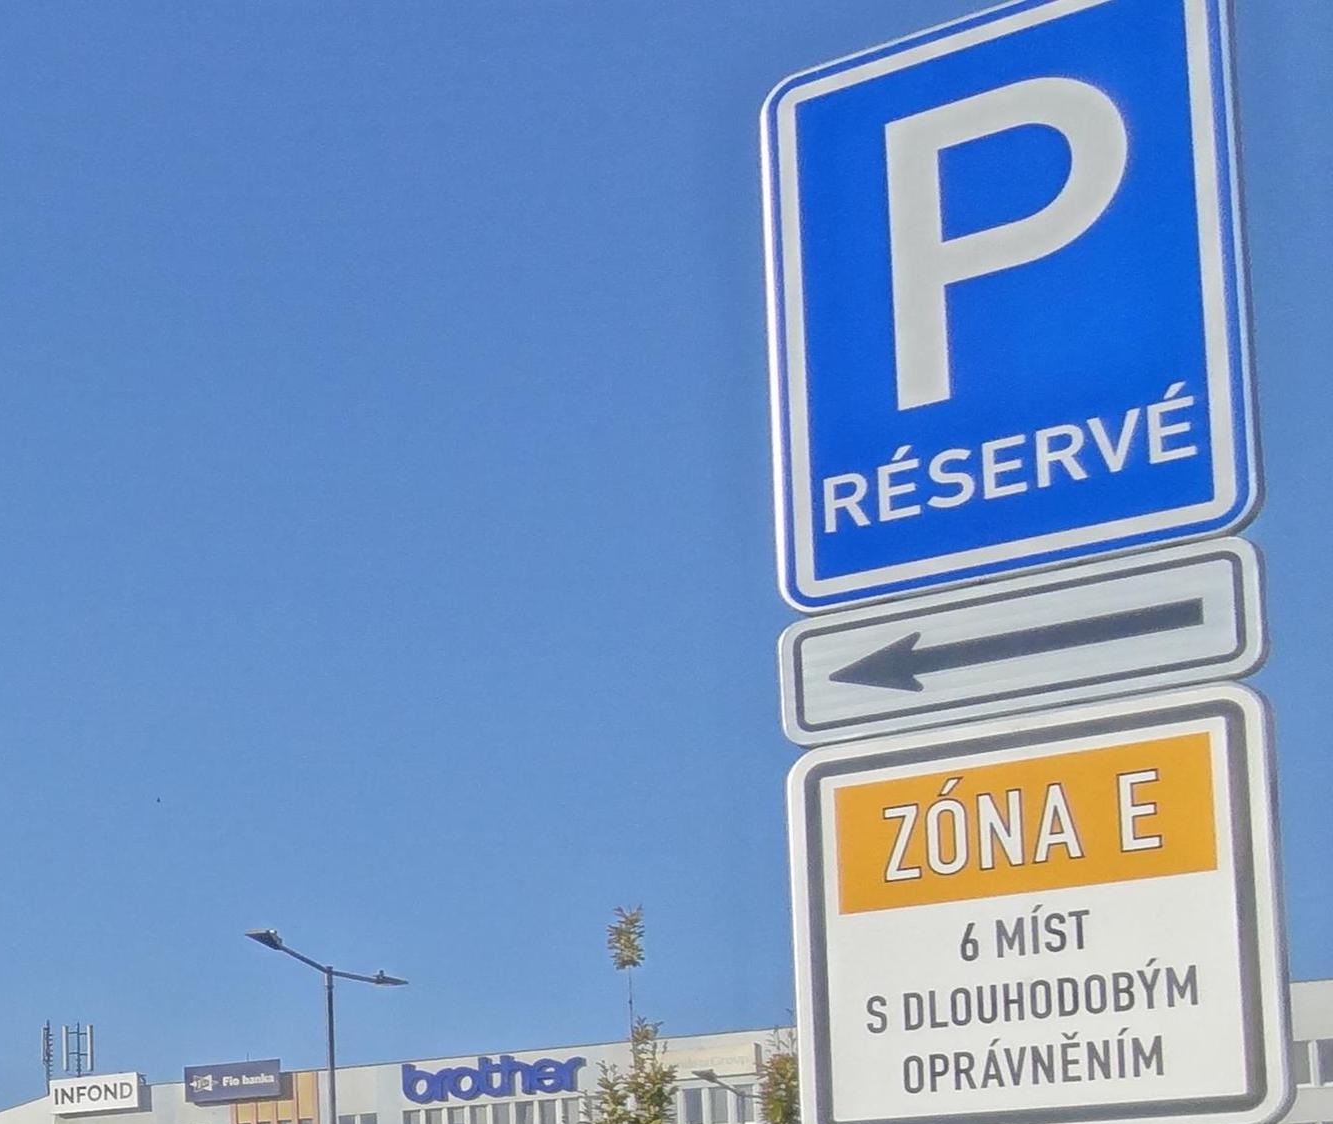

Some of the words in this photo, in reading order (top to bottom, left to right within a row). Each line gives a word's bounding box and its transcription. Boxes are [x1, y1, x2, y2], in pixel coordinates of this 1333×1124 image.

[884, 76, 1128, 412] P
[822, 381, 1199, 534] RÉSERVÉ
[881, 776, 1085, 883] ZÓNA
[1116, 768, 1163, 854] E
[959, 921, 980, 962] 6
[995, 904, 1091, 958] MÍST
[866, 995, 889, 1034] S
[902, 958, 1199, 1032] DLOUHODOBÝM
[54, 1082, 133, 1106] INFOND
[222, 1077, 240, 1087] Fio
[242, 1072, 275, 1085] banka
[401, 1055, 587, 1105] brother
[902, 1026, 1165, 1095] OPRÁVNĚNÍM
